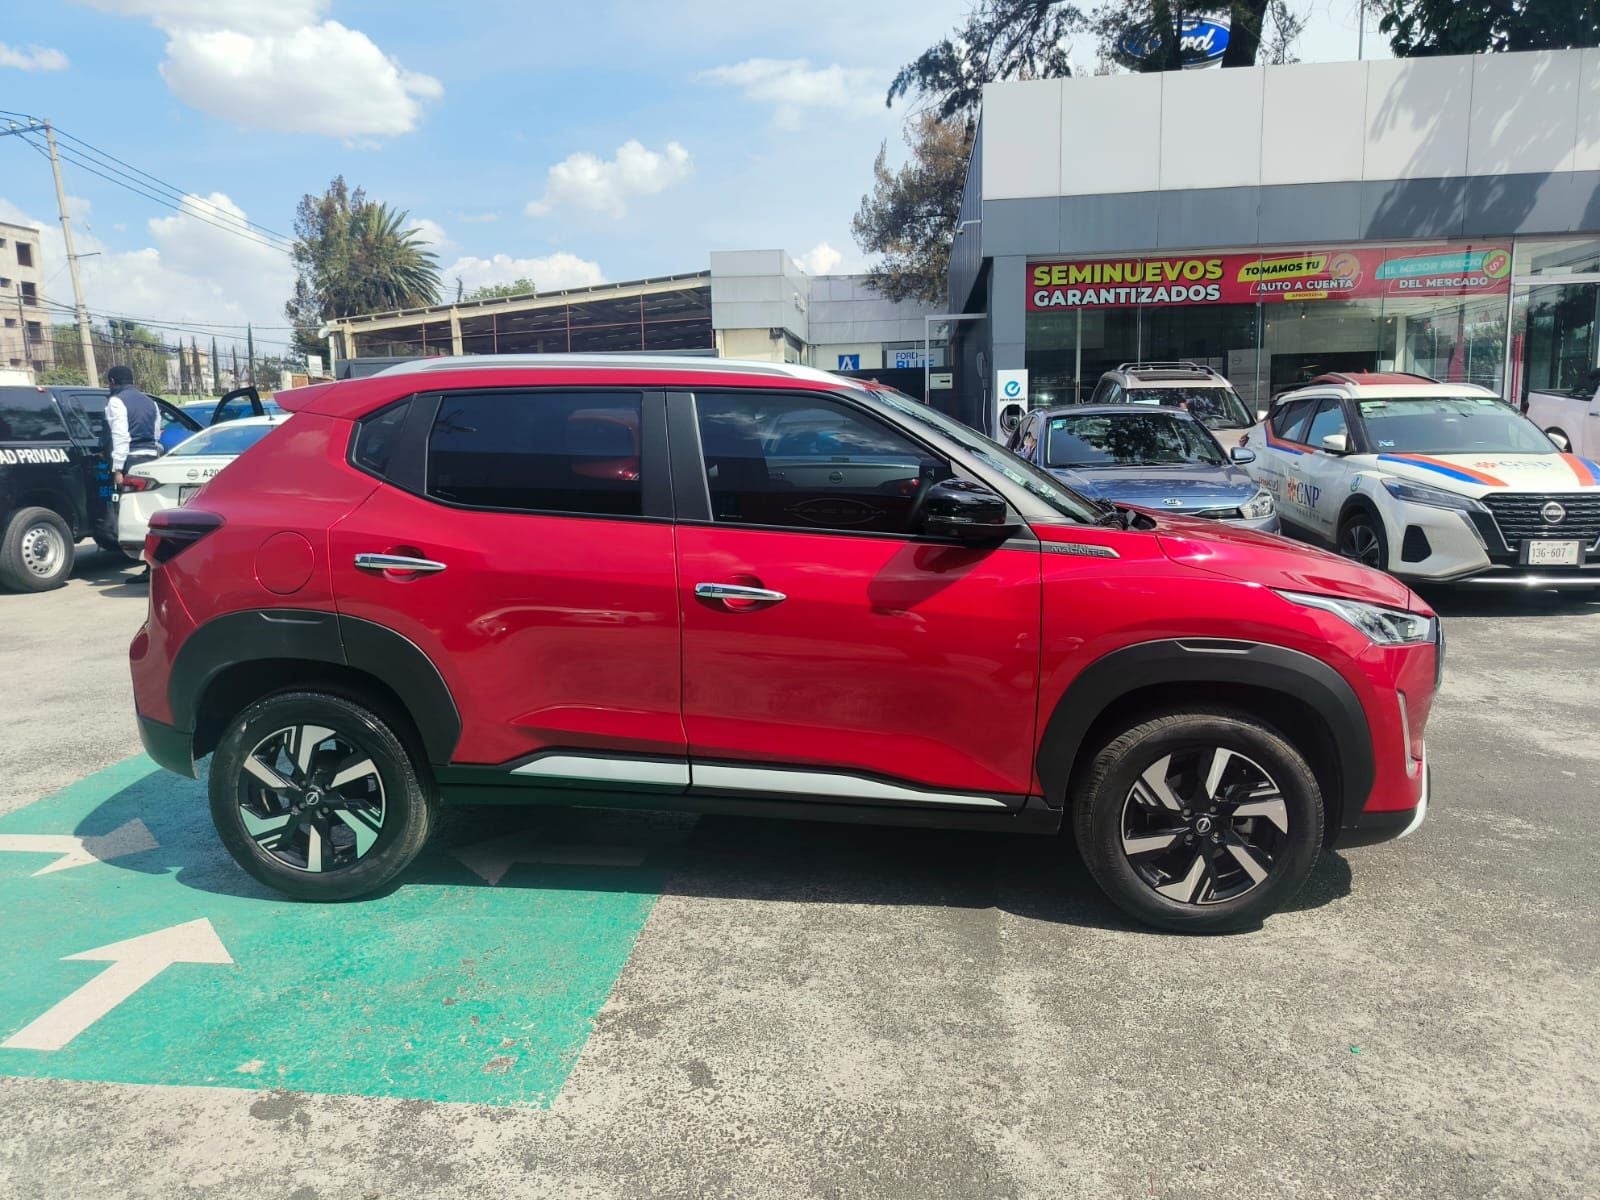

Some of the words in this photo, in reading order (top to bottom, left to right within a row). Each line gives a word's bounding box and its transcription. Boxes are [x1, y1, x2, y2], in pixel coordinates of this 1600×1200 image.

[1034, 259, 1223, 287] SEMINUEVOS
[1245, 262, 1303, 276] TOMAMOS
[1306, 261, 1320, 270] TU
[1257, 281, 1292, 291] AUTO
[1294, 280, 1304, 290] A
[1306, 279, 1354, 290] CUENTA
[1400, 279, 1423, 289] DEL
[1426, 276, 1489, 288] MERCADO
[1034, 284, 1221, 307] GARANTIZADOS
[896, 352, 918, 360] FORD
[15, 448, 70, 464] PRIVADA
[1296, 481, 1320, 508] GNP
[1050, 546, 1105, 556] MAGNITE
